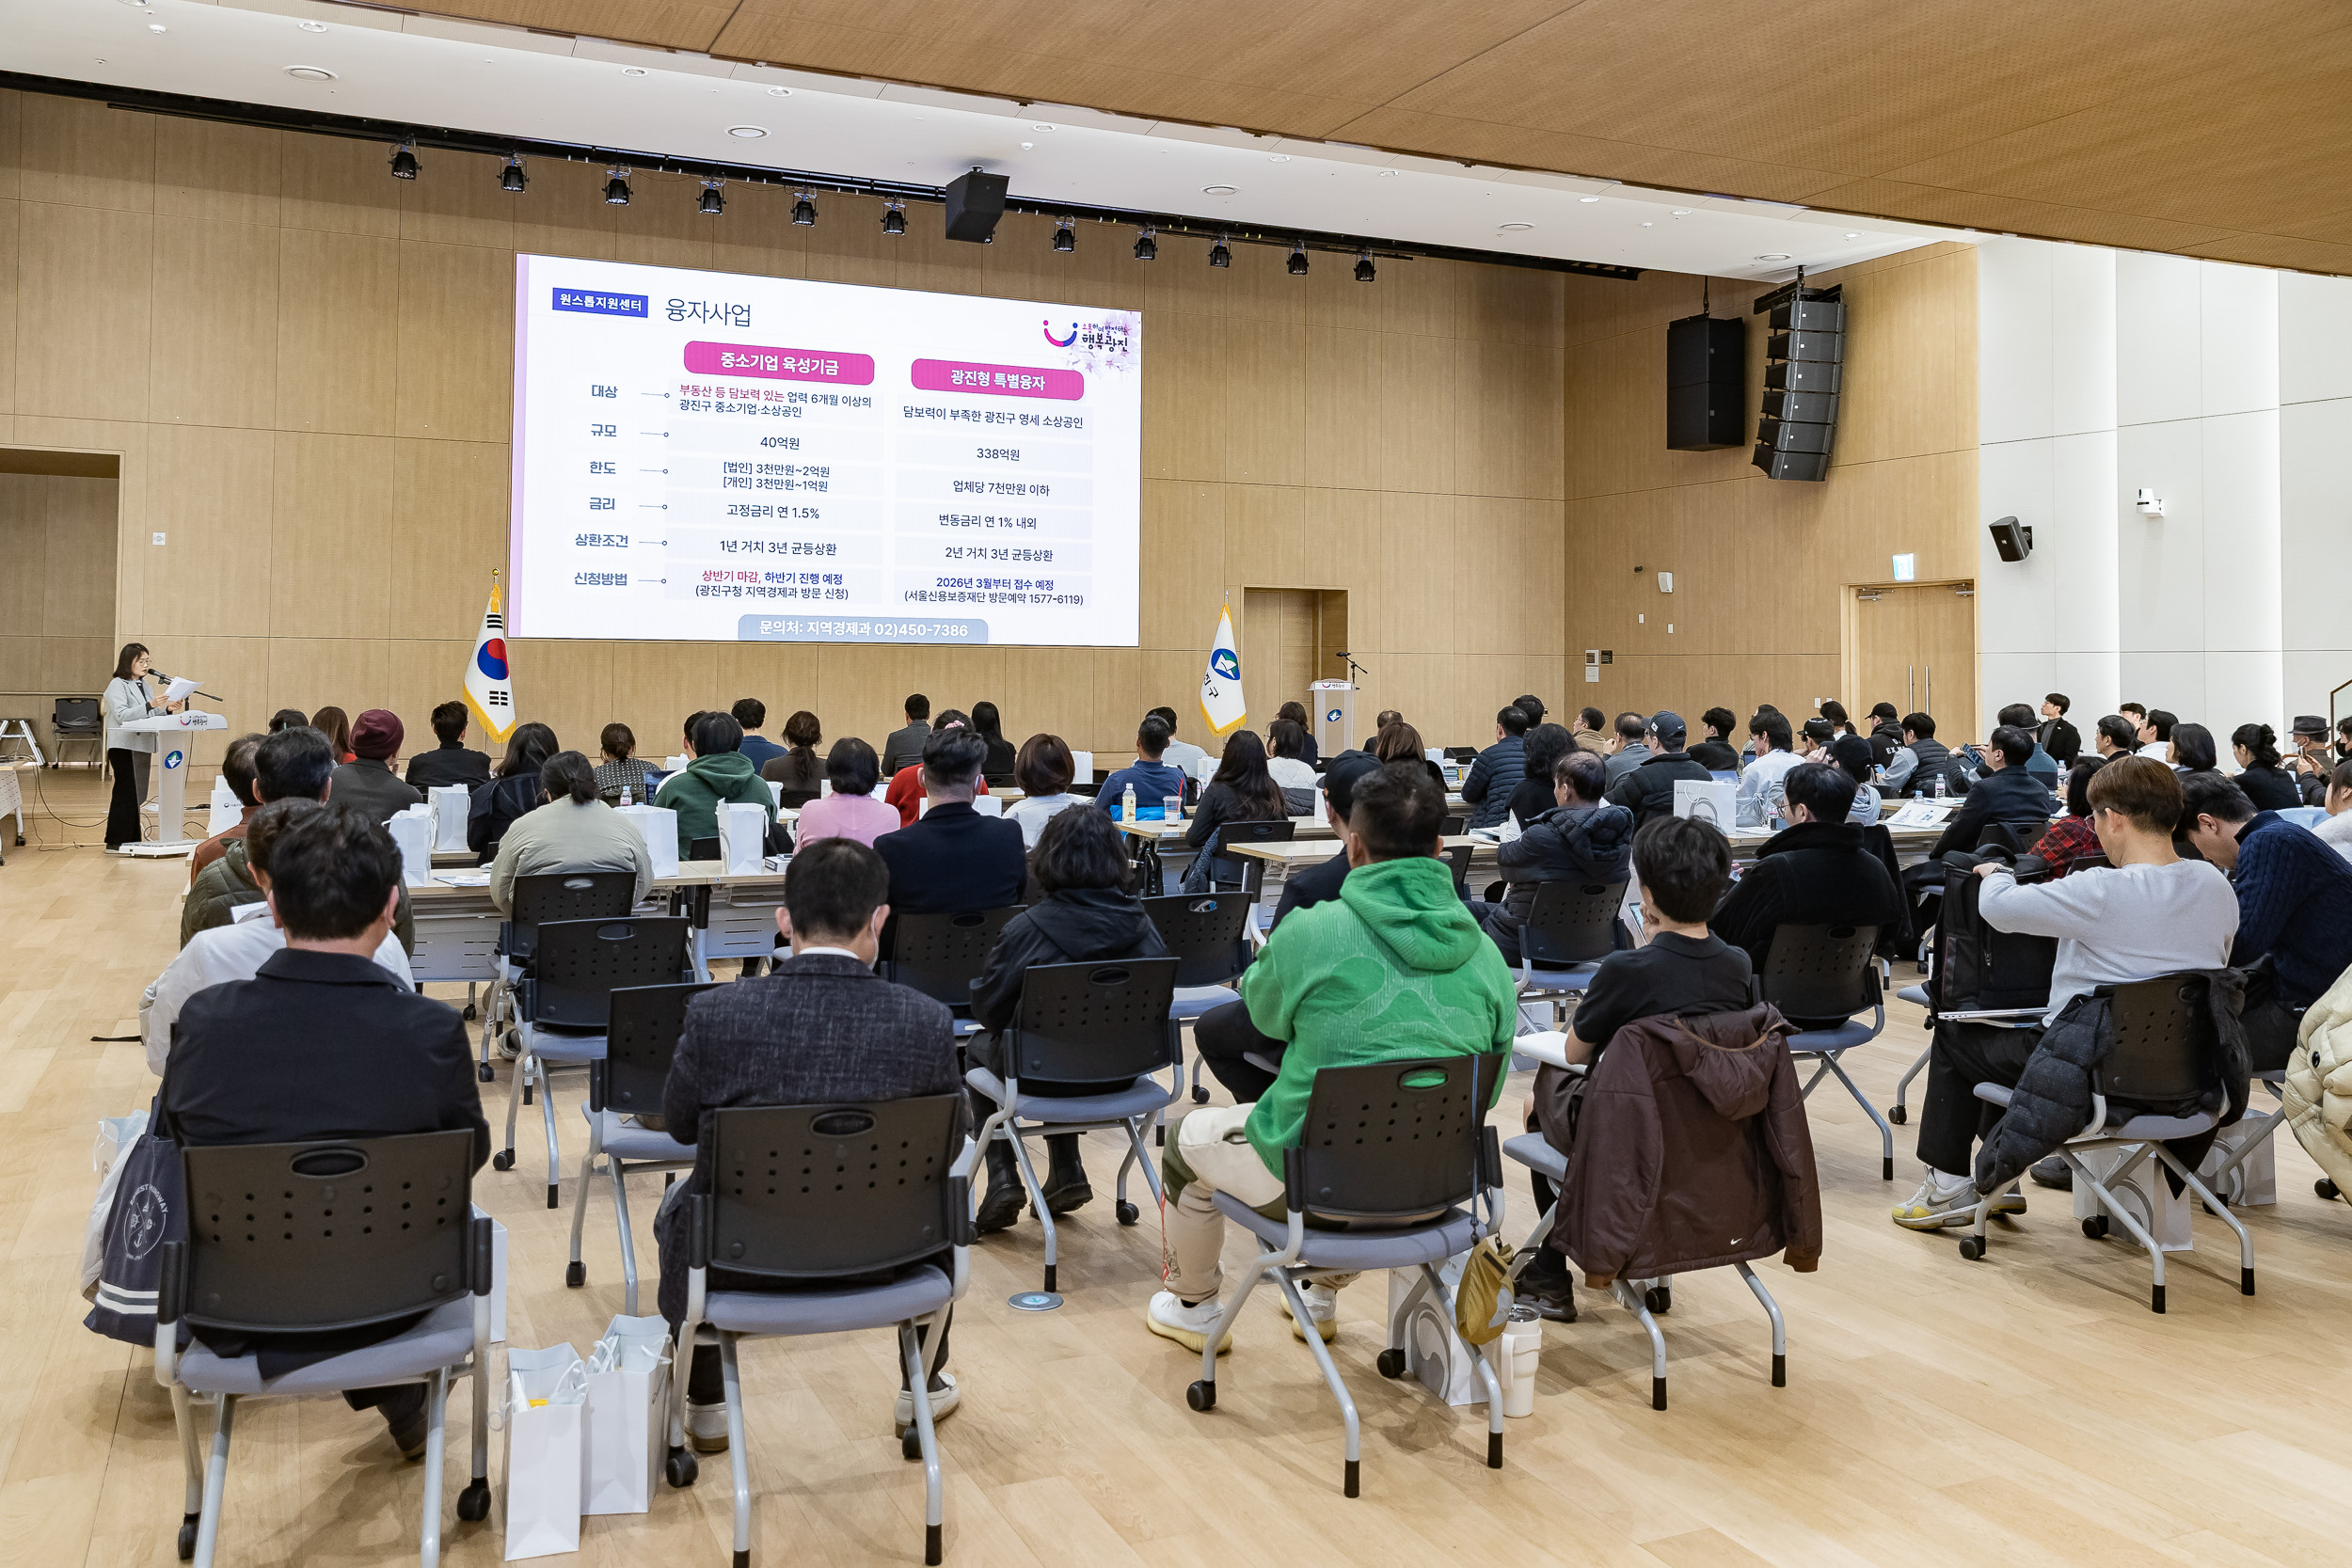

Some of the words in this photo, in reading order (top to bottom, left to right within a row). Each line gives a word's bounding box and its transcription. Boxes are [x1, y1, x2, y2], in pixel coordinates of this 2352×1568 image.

[560, 293, 642, 312] 원스톱지원센터
[665, 298, 751, 327] 융자사업
[1082, 333, 1127, 352] 행복광진
[721, 352, 778, 372] 중소기업
[783, 356, 839, 375] 육성기금
[951, 370, 991, 387] 광진형
[993, 372, 1045, 391] 특별융자
[591, 384, 618, 398] 대상
[679, 385, 712, 398] 부동산
[715, 388, 725, 399] 등
[729, 388, 760, 400] 담보력
[764, 390, 785, 403] 있는
[787, 391, 808, 404] 업력
[811, 393, 838, 405] 6개월
[842, 395, 871, 408] 이상의
[679, 400, 711, 412] 광진구
[715, 402, 802, 418] 중소기업·소상공인
[903, 405, 946, 420] 담보력이
[949, 408, 981, 422] 부족한
[985, 412, 1016, 424] 광진구
[1019, 413, 1040, 426] 영세
[1042, 416, 1083, 429] 소상공인
[591, 424, 617, 437] 규모
[760, 436, 800, 451] 40억원
[977, 448, 1020, 461] 338억원
[590, 461, 616, 474] 한도
[723, 462, 753, 474] [법인]
[756, 465, 830, 478] 3천만원~2억원
[723, 477, 752, 490] [개인]
[755, 479, 828, 492] 3천만원~1억원
[953, 481, 985, 494] 업체당
[988, 483, 1025, 496] 7천만원
[1029, 483, 1050, 497] 이하
[589, 498, 615, 510] 금리
[727, 504, 773, 517] 고정금리
[777, 506, 788, 518] 연
[792, 507, 819, 519] 1.5%
[939, 514, 981, 527] 변동금리
[985, 515, 994, 528] 연
[998, 517, 1013, 529] 1%
[1016, 517, 1037, 530] 내외
[576, 534, 628, 547] 상환조건
[720, 540, 738, 553] 1년
[741, 541, 764, 553] 거치
[769, 542, 787, 554] 3년
[791, 543, 837, 556] 균등상환
[946, 546, 963, 559] 2년
[966, 547, 987, 560] 거치
[991, 548, 1009, 560] 3년
[1011, 549, 1053, 562] 균등상환
[575, 572, 628, 586] 신청방법
[702, 570, 734, 582] 상반기
[737, 571, 761, 584] 마감,
[765, 572, 796, 584] 하반기
[799, 573, 819, 585] 진행
[822, 573, 843, 585] 예정
[936, 578, 973, 589] 2026년
[977, 578, 1011, 590] 3월부터
[1014, 579, 1032, 590] 접수
[1036, 579, 1054, 591] 예정
[696, 585, 742, 597] (광진구청
[745, 586, 798, 598] 지역경제과
[801, 588, 821, 599] 방문
[824, 589, 849, 600] 신청)
[904, 591, 986, 603] (서울신용보증재단
[989, 592, 1026, 604] 방문예약
[1029, 594, 1084, 606] 1577-6119)
[759, 620, 803, 635] 문의처:
[806, 621, 871, 637] 지역경제과
[875, 623, 968, 638] 02)450-7386
